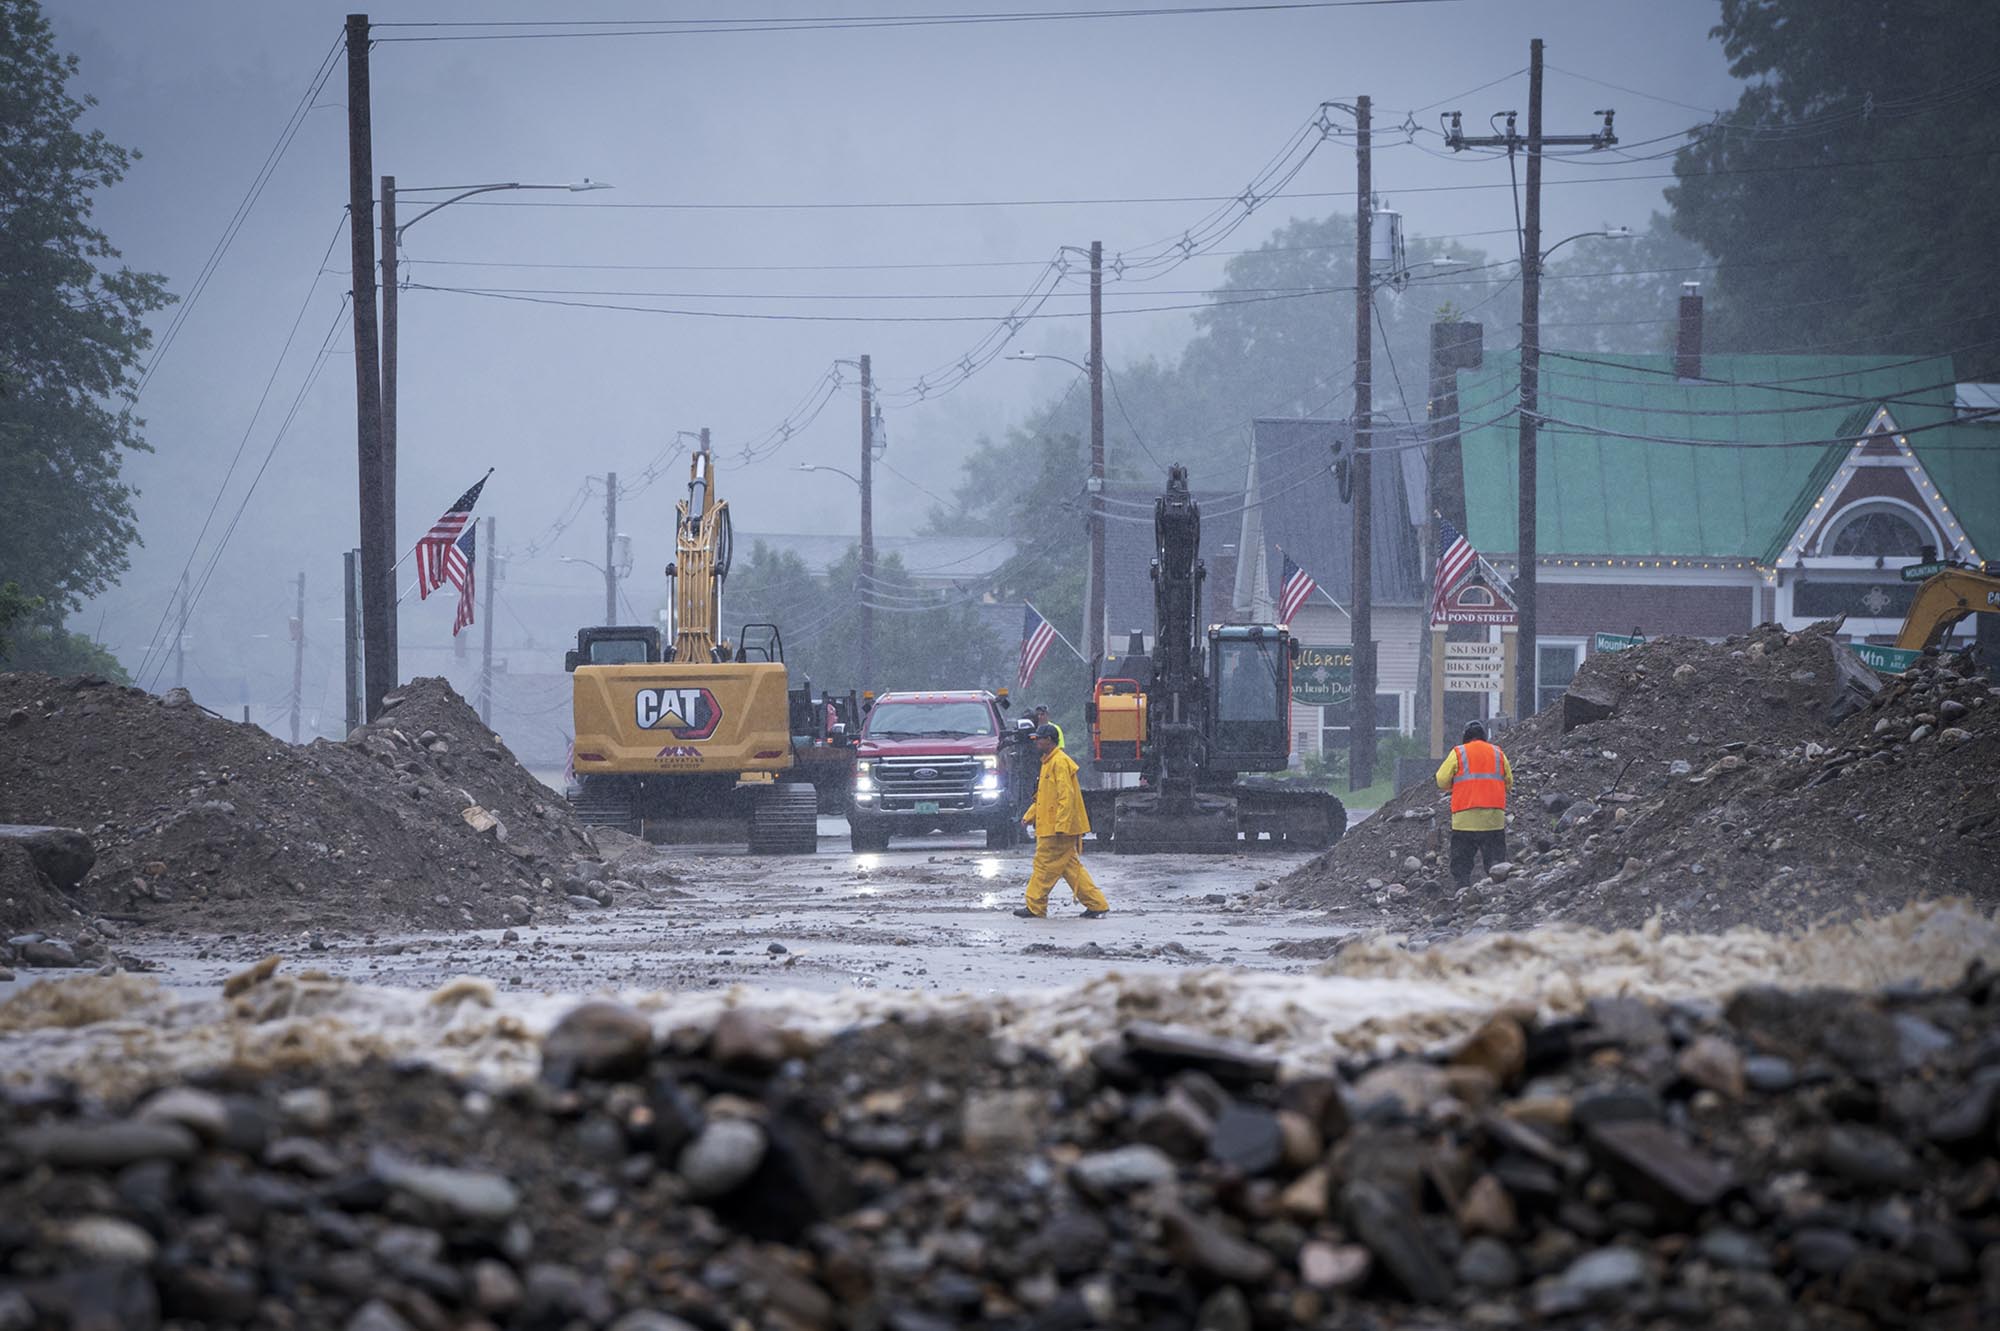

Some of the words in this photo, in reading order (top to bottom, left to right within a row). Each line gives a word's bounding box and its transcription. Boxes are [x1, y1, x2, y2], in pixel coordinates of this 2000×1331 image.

[1987, 591, 2000, 605] CA
[1448, 613, 1476, 622] POND
[1477, 614, 1515, 623] STREET
[1450, 645, 1468, 654] SKI
[1471, 645, 1498, 654] SHOP
[1598, 637, 1629, 650] Mounta
[1291, 650, 1352, 670] illarne
[1860, 650, 1884, 666] Mtn
[1447, 663, 1472, 671] BIKE
[1474, 663, 1502, 672] SHOP
[1450, 680, 1498, 689] RENTALS
[637, 689, 700, 729] CAT
